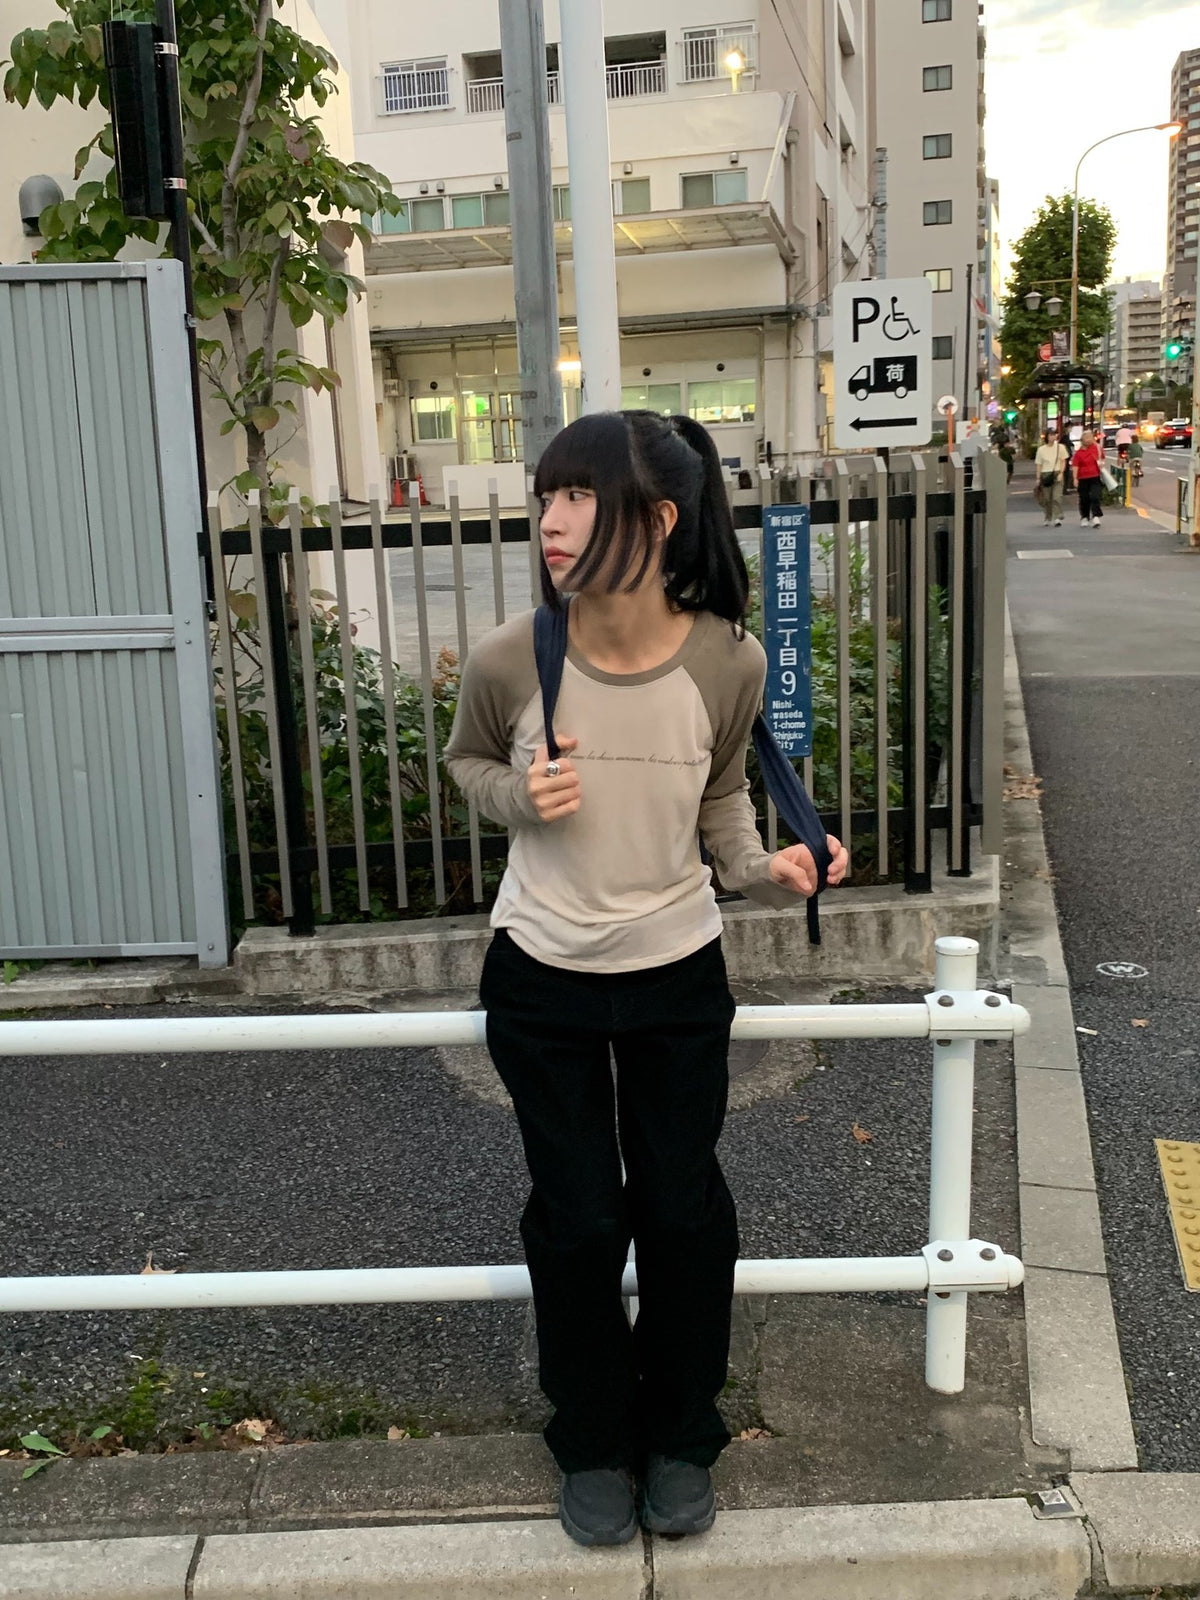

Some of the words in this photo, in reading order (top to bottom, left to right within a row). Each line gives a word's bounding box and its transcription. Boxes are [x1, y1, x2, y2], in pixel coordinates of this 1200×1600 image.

[852, 297, 880, 343] P
[886, 363, 905, 383] 荷
[771, 515, 803, 527] 新宿区
[772, 700, 795, 709] Nishi-
[773, 710, 803, 719] waseda
[773, 720, 806, 729] 1-chome
